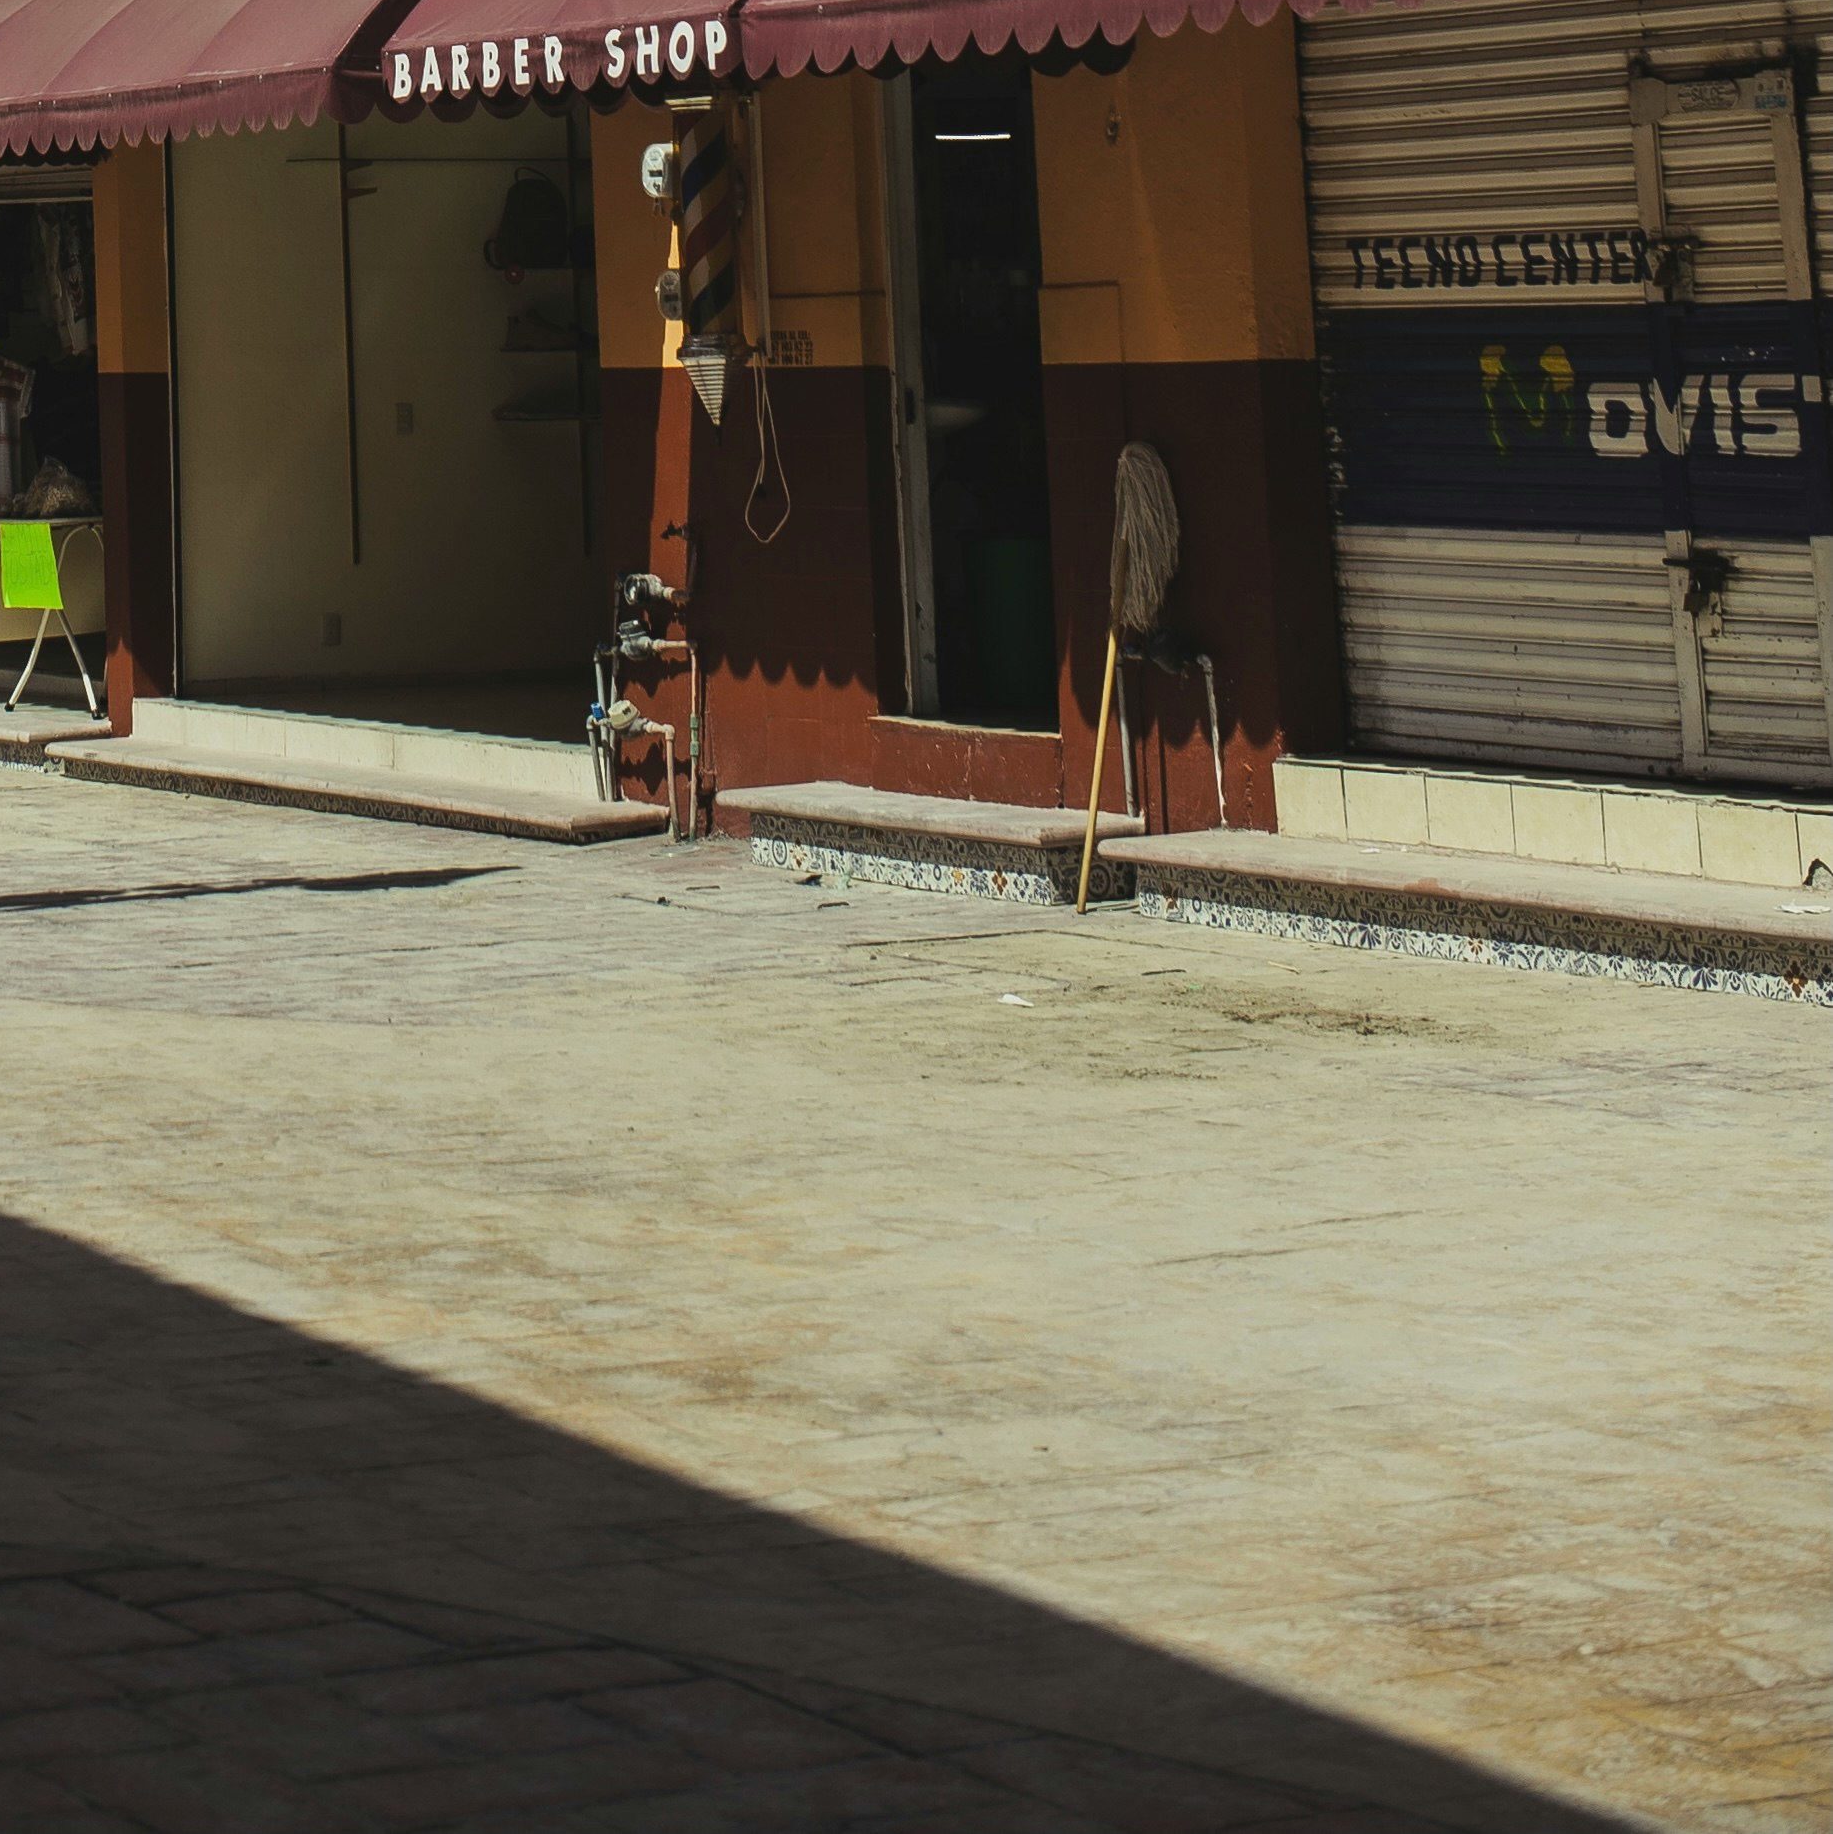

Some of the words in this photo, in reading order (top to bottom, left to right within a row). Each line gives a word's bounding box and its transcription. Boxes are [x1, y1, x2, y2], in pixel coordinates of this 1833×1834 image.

[393, 35, 565, 99] BARBER
[604, 20, 728, 79] SHOP
[1346, 235, 1483, 290] TECNO
[1491, 228, 1654, 286] CENTER
